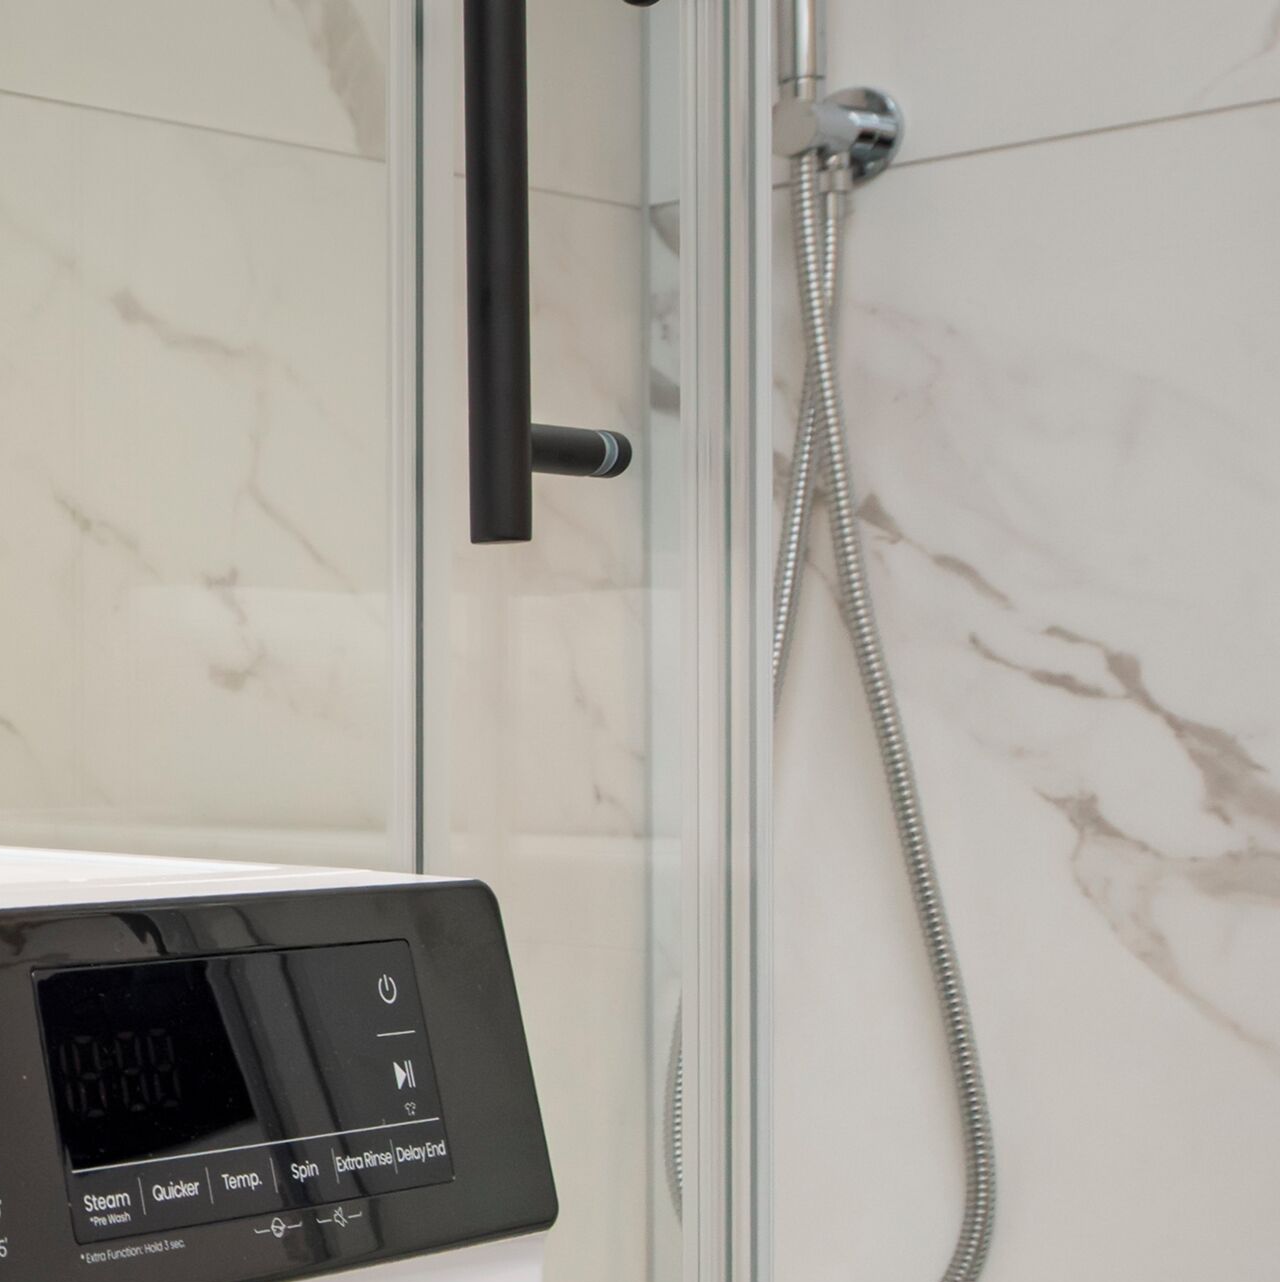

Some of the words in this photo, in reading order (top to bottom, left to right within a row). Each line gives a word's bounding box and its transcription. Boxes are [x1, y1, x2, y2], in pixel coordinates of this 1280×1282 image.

[336, 1155, 364, 1173] Extra
[364, 1150, 393, 1169] Rinse
[395, 1144, 427, 1164] Delay
[426, 1139, 447, 1159] End
[222, 1172, 263, 1191] Temp.
[291, 1161, 320, 1183] Spin
[83, 1191, 131, 1213] Steam
[152, 1180, 200, 1202] Quicker
[108, 1212, 131, 1224] Wash
[86, 1249, 107, 1264] Extra
[145, 1240, 164, 1254] Hold
